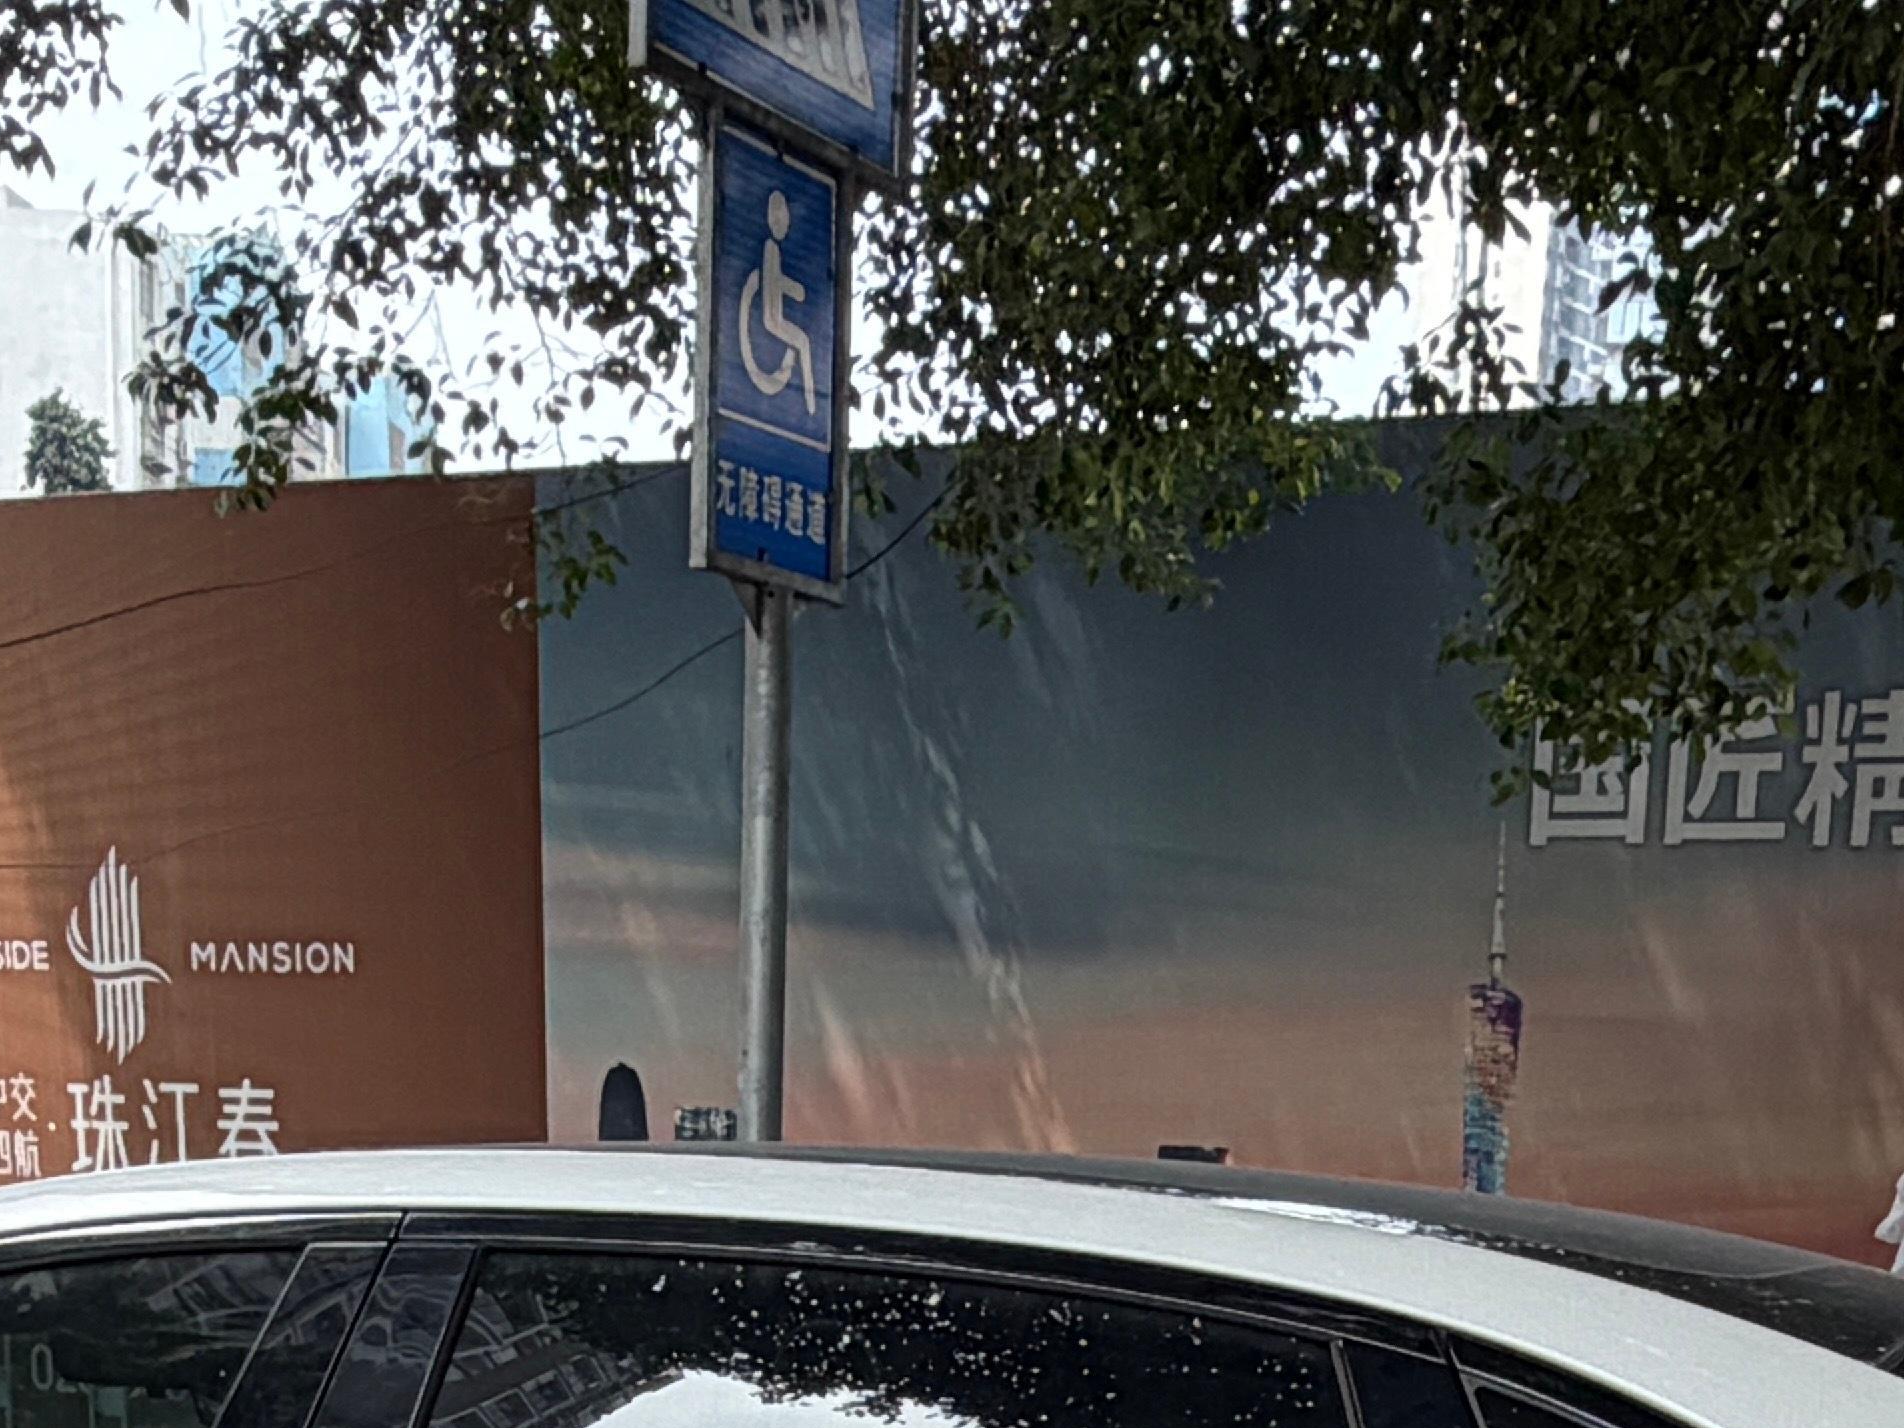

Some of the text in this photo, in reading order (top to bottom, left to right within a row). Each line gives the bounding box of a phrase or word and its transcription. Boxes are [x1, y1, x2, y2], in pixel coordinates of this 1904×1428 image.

[716, 459, 826, 546] 无障碍通道
[191, 941, 356, 975] MANSION
